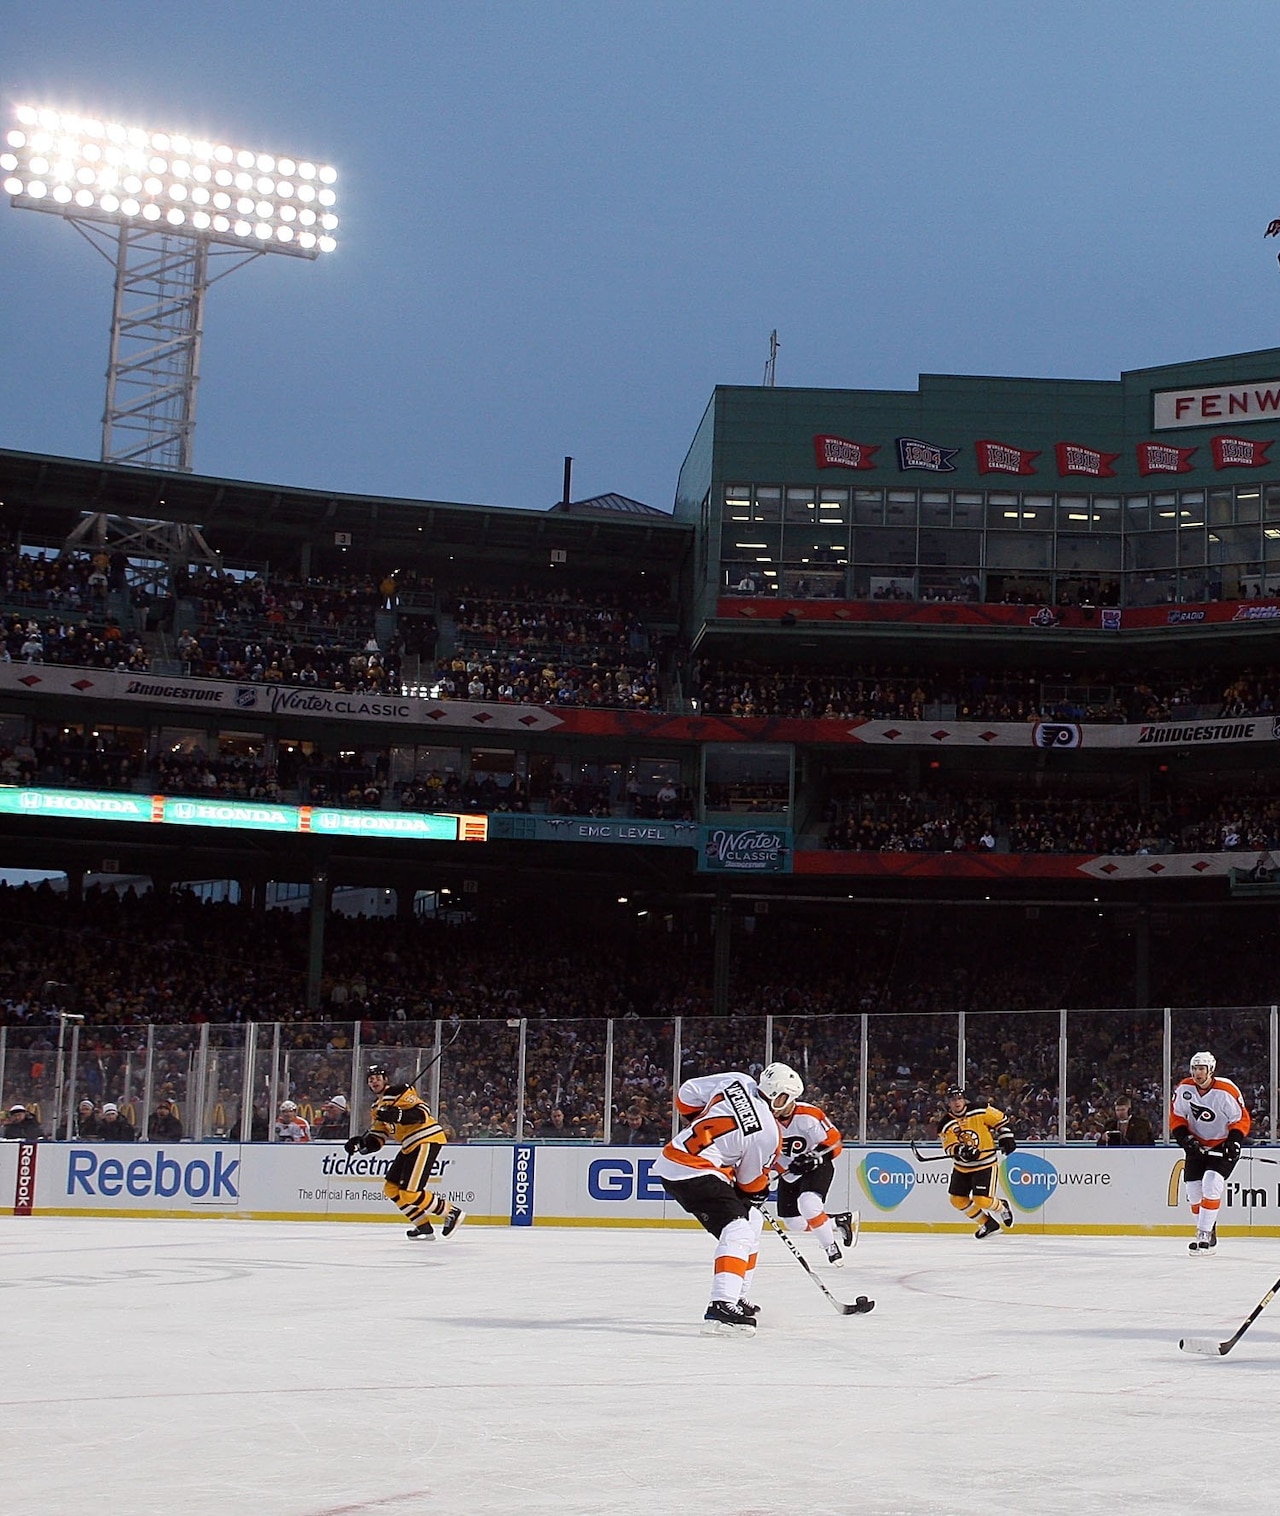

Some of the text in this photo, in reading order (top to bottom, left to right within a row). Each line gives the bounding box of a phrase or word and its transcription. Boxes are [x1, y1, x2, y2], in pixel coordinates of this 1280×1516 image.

[824, 443, 861, 462] 1903
[905, 446, 941, 465] 1904
[987, 449, 1021, 468] 1912
[1067, 451, 1100, 469] 1915
[1148, 450, 1178, 466] 1916
[1222, 443, 1253, 460] 1918
[125, 681, 224, 701] BRIDGESTONE
[266, 686, 334, 713] Winter
[335, 702, 410, 717] CLASSIC
[1138, 723, 1255, 743] BRIDGESTONE
[45, 798, 139, 813] HONDA
[197, 808, 288, 825] HONDA
[339, 816, 430, 832] HONDA
[578, 825, 665, 841] EMC LEVEL
[713, 830, 782, 856] Winter
[726, 851, 778, 861] CLASSIC
[67, 1150, 240, 1197] Reebok
[322, 1153, 450, 1176] ticketmer
[17, 1144, 34, 1206] Reebok
[515, 1148, 530, 1215] Reebok
[867, 1167, 949, 1189] Compuwa
[1008, 1167, 1111, 1190] Compuware
[298, 1189, 313, 1200] The
[315, 1188, 342, 1201] Official
[346, 1189, 360, 1201] Fan
[1227, 1183, 1266, 1207] i'm
